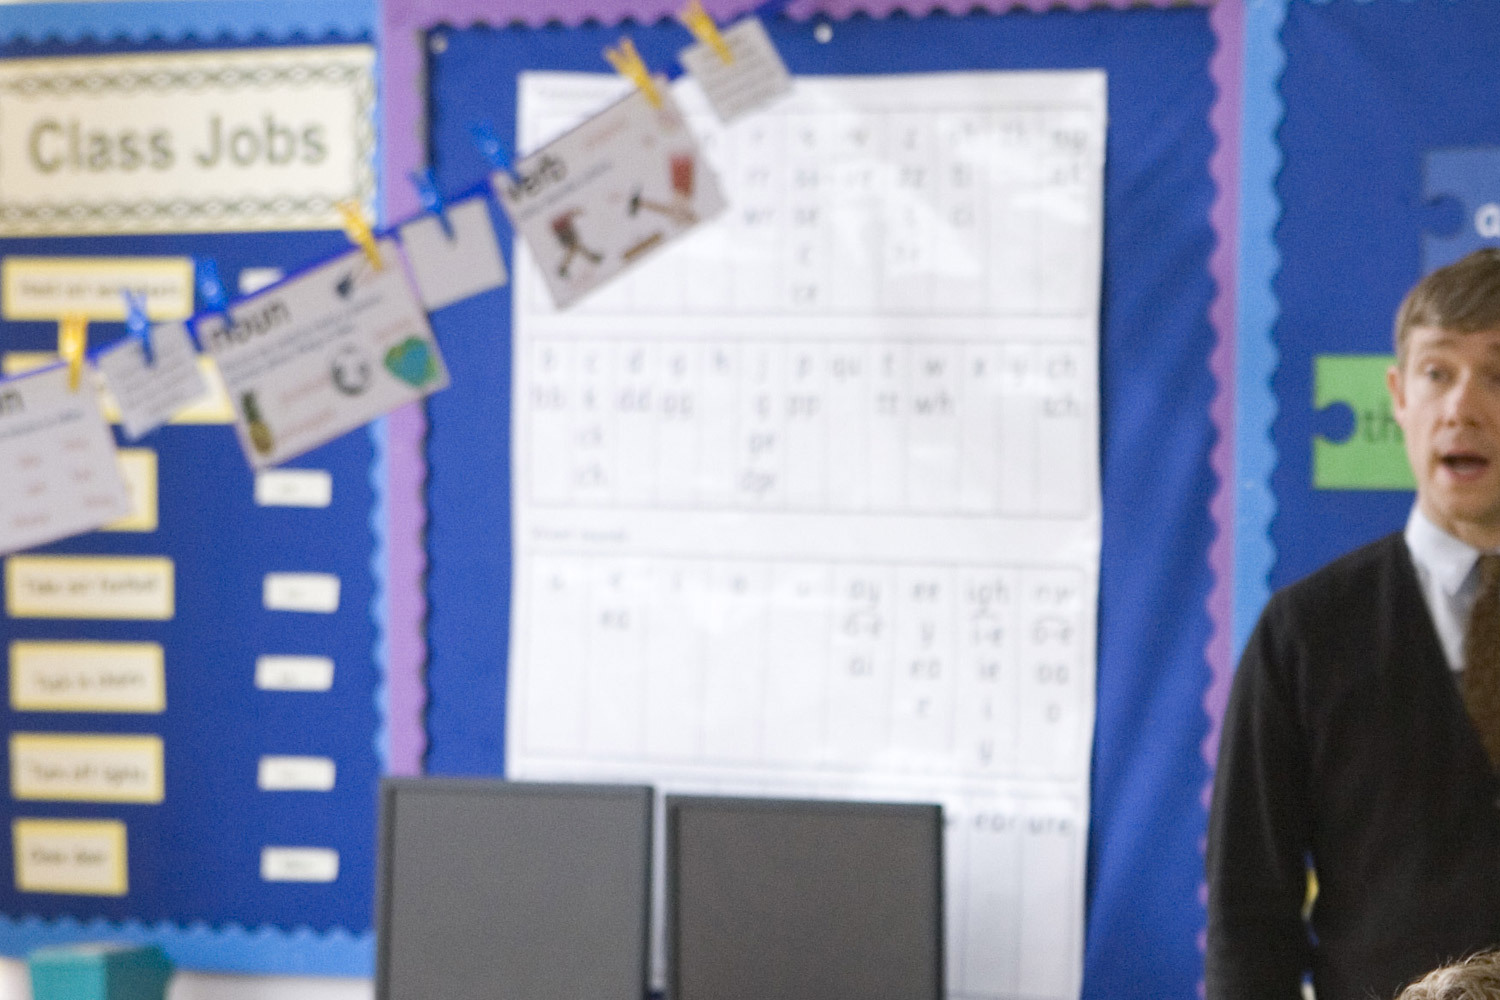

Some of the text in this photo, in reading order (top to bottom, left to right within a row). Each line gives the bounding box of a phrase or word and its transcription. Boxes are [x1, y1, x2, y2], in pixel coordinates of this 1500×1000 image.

[29, 110, 329, 174] Class Jobs
[507, 156, 568, 203] verb
[210, 300, 293, 347] noun
